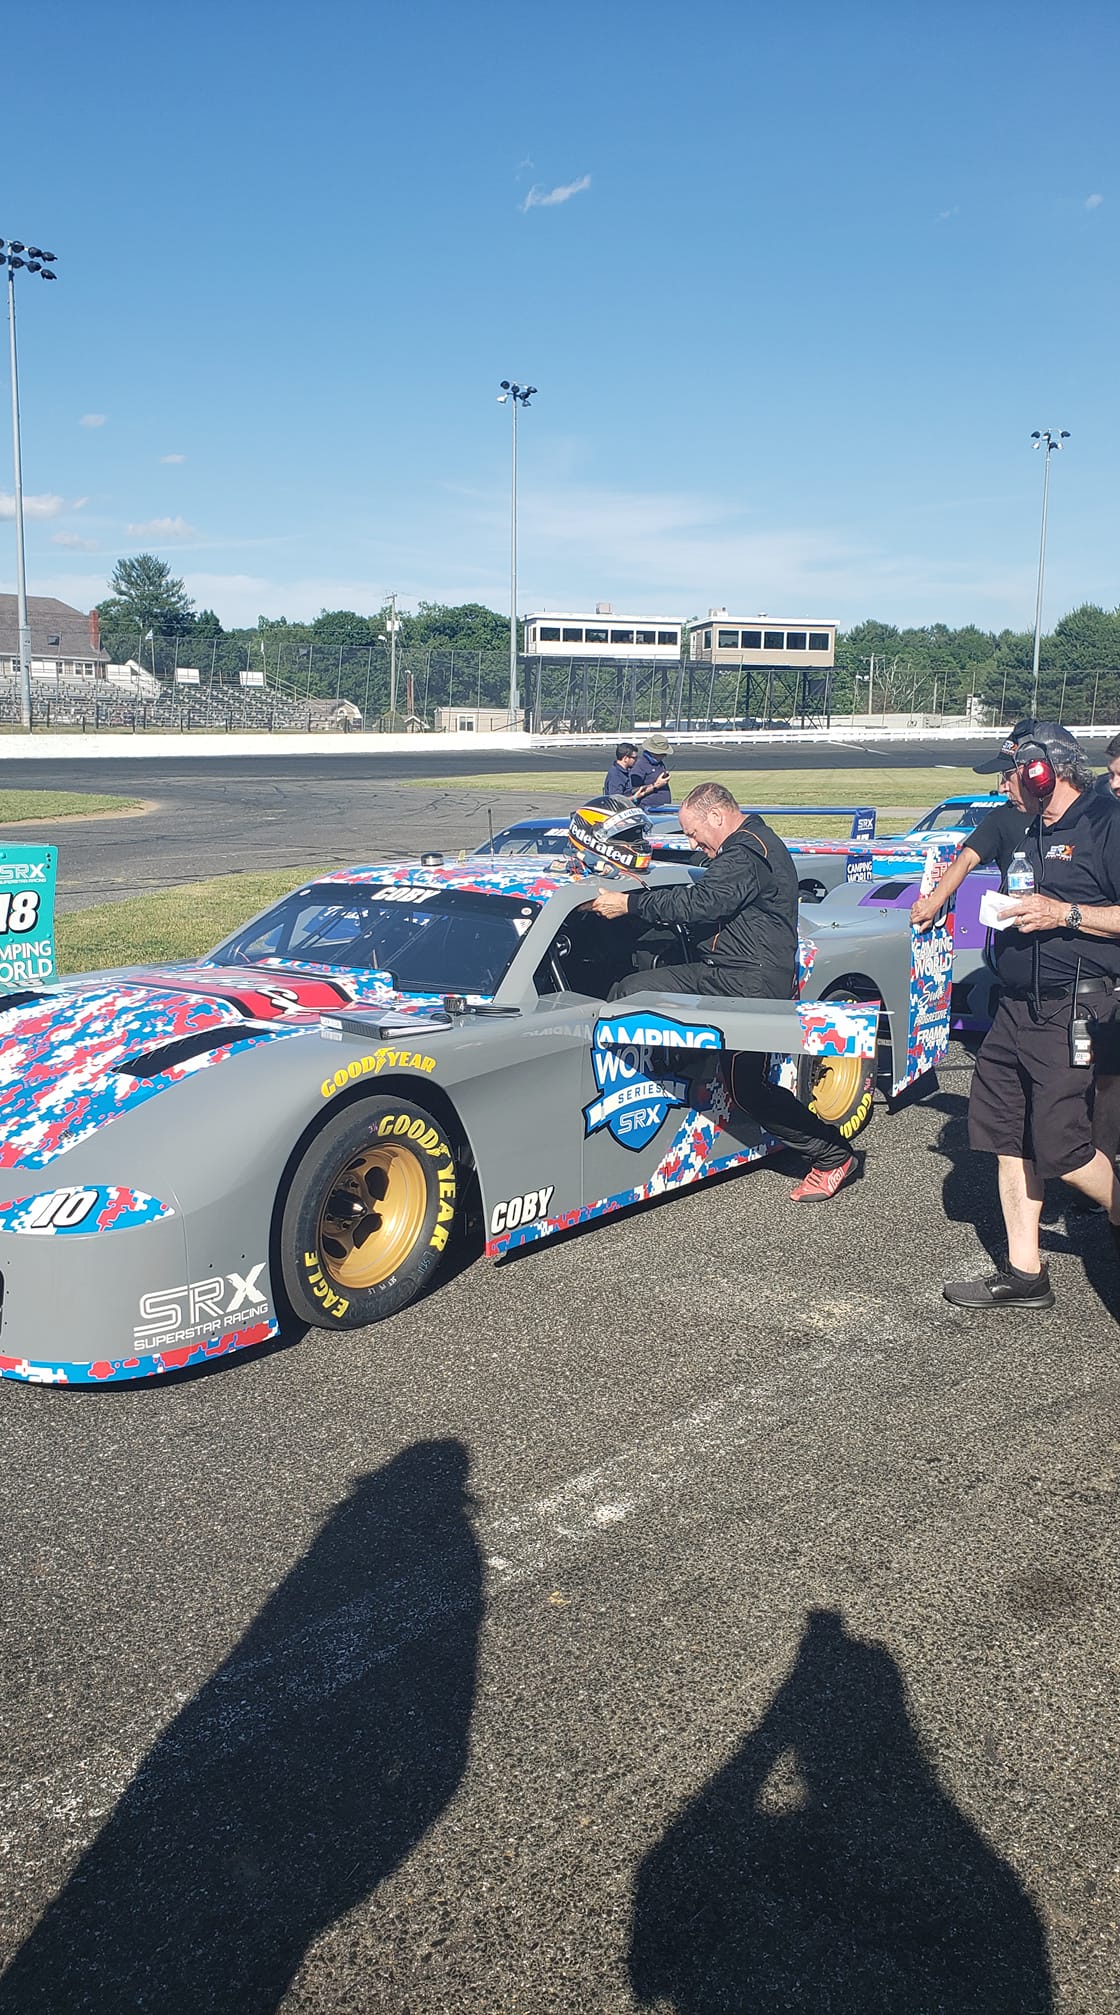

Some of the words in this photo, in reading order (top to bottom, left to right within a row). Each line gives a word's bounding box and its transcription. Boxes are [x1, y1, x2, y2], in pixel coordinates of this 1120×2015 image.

[0, 863, 46, 879] SRX
[847, 861, 872, 874] CAMPING
[931, 862, 953, 878] SR
[371, 886, 441, 904] COBY
[0, 889, 41, 935] 18
[0, 940, 52, 961] MPING
[914, 936, 953, 960] CAMPING
[0, 959, 53, 983] ORLD
[914, 954, 951, 979] WORLD
[597, 1025, 716, 1050] AMPING
[595, 1045, 656, 1085] WOR
[618, 1083, 662, 1104] SERIES
[617, 1103, 661, 1135] SRX
[840, 1092, 872, 1139] GOOD
[30, 1190, 99, 1230] 10
[490, 1185, 554, 1235] COBY
[304, 1250, 350, 1319] EAGLE
[133, 1262, 267, 1338] SRX
[134, 1320, 221, 1351] SUPERSTAR
[223, 1302, 269, 1328] RACING
